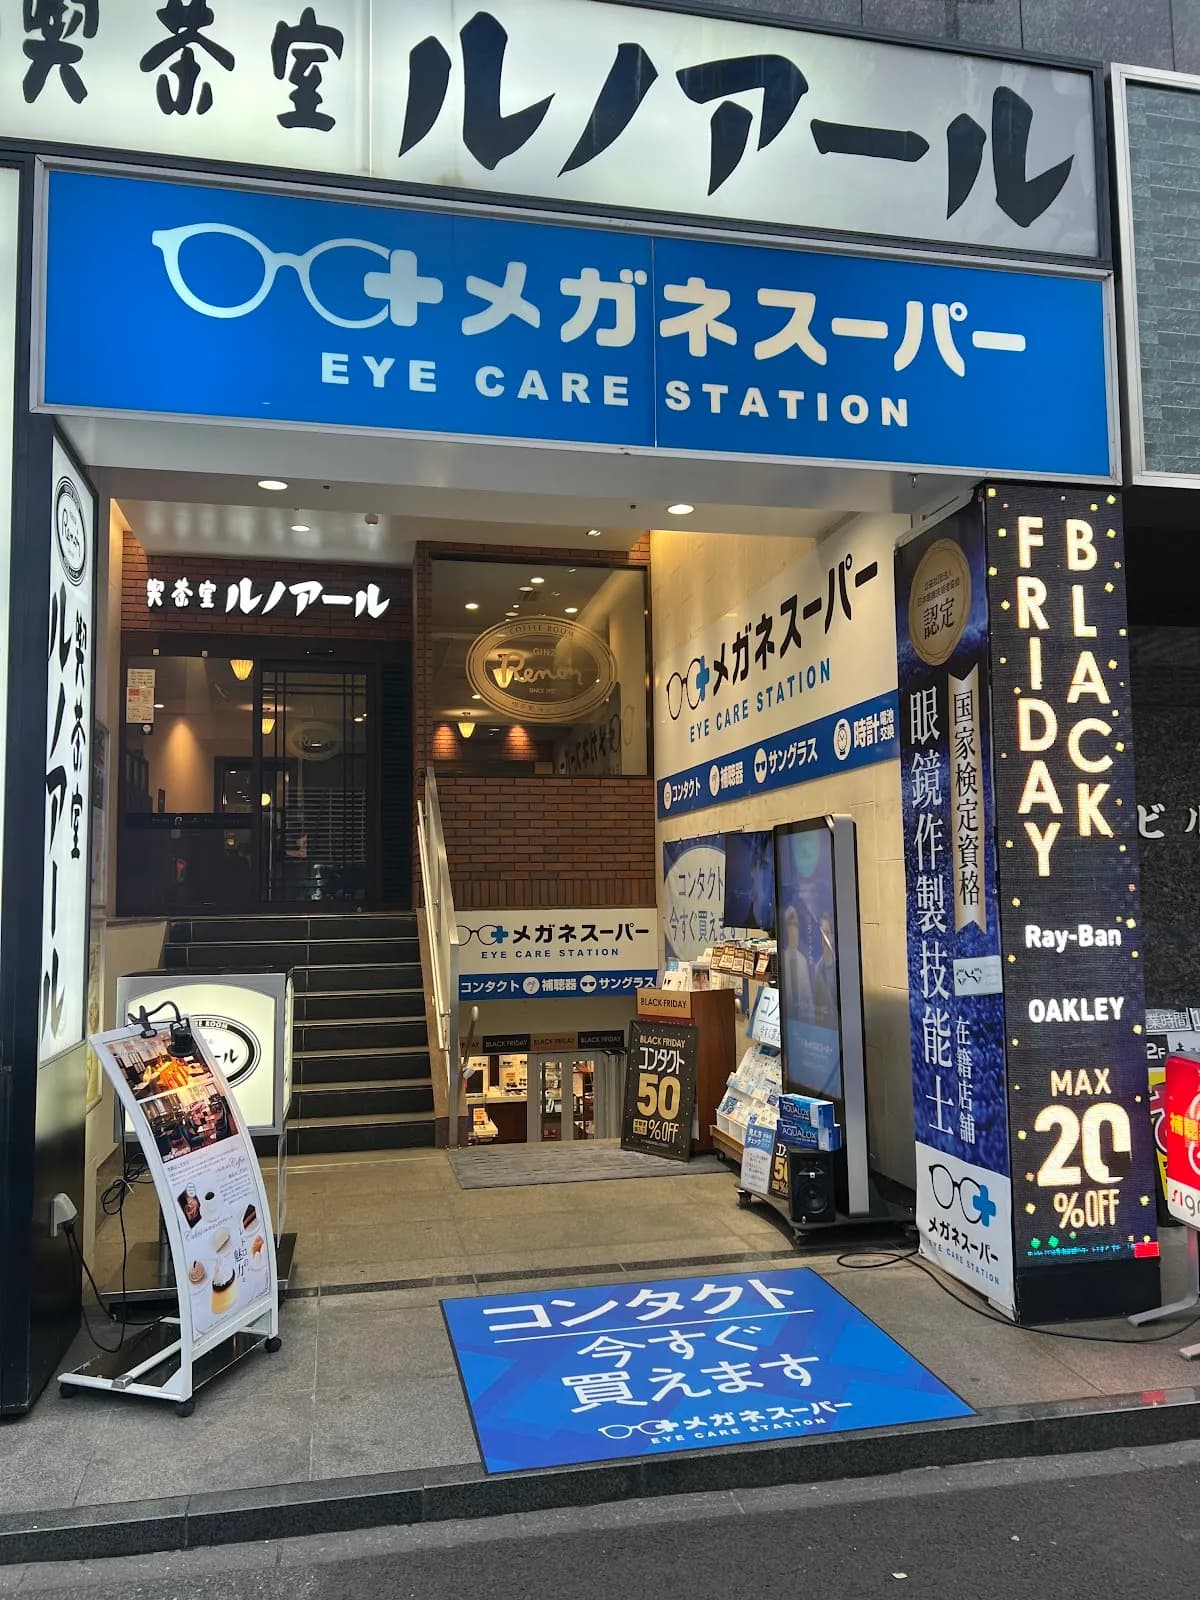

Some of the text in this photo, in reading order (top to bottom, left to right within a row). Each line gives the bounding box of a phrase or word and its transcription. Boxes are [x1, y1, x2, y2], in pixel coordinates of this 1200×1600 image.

[461, 261, 1027, 377] メガネスーパー
[321, 351, 910, 429] EYE CARE STATION
[713, 553, 878, 697] メガネスーパー
[924, 597, 955, 640] 認定
[1016, 515, 1064, 878] FRIDAY
[1066, 518, 1114, 838] BLACK
[689, 657, 831, 743] EYE CARE STATION
[71, 606, 87, 860] 喫茶室
[853, 713, 879, 749] 時計
[769, 737, 818, 775] サングラス
[672, 776, 701, 802] コンタクト
[953, 690, 980, 906] 国家検定資格
[43, 582, 71, 1041] ルノアール
[678, 866, 724, 902] コンタクト
[909, 685, 955, 1136] 眼鏡作製技能士
[512, 922, 649, 944] メガネスーパー
[1025, 924, 1123, 953] Ray-Ban
[481, 948, 620, 959] EYE CARE STATION
[460, 979, 520, 994] コンタクト
[541, 978, 577, 992] 補聴器
[598, 976, 655, 990] サングラス
[640, 997, 688, 1010] BLACK FRIDAY
[1028, 996, 1125, 1023] OAKLEY
[486, 1040, 505, 1048] BLACK
[506, 1039, 528, 1047] FRIDAY
[639, 1034, 686, 1049] BLACK FRIDAY
[638, 1046, 686, 1075] コンタクト
[636, 1072, 681, 1120] 50
[1050, 1067, 1112, 1097] MAX
[648, 1119, 680, 1144] %OFF
[782, 1127, 817, 1140] AQUALOX
[1053, 1189, 1120, 1230] %OFF
[928, 1216, 999, 1265] メガネスーパー
[928, 1238, 1000, 1286] EYE CARE STATION
[482, 1278, 796, 1334] コンタクト
[576, 1324, 763, 1369] 今すぐ
[561, 1353, 820, 1414] 買えます
[649, 1416, 828, 1446] EYE CARE STATION
[682, 1400, 853, 1435] メガネスーパー
